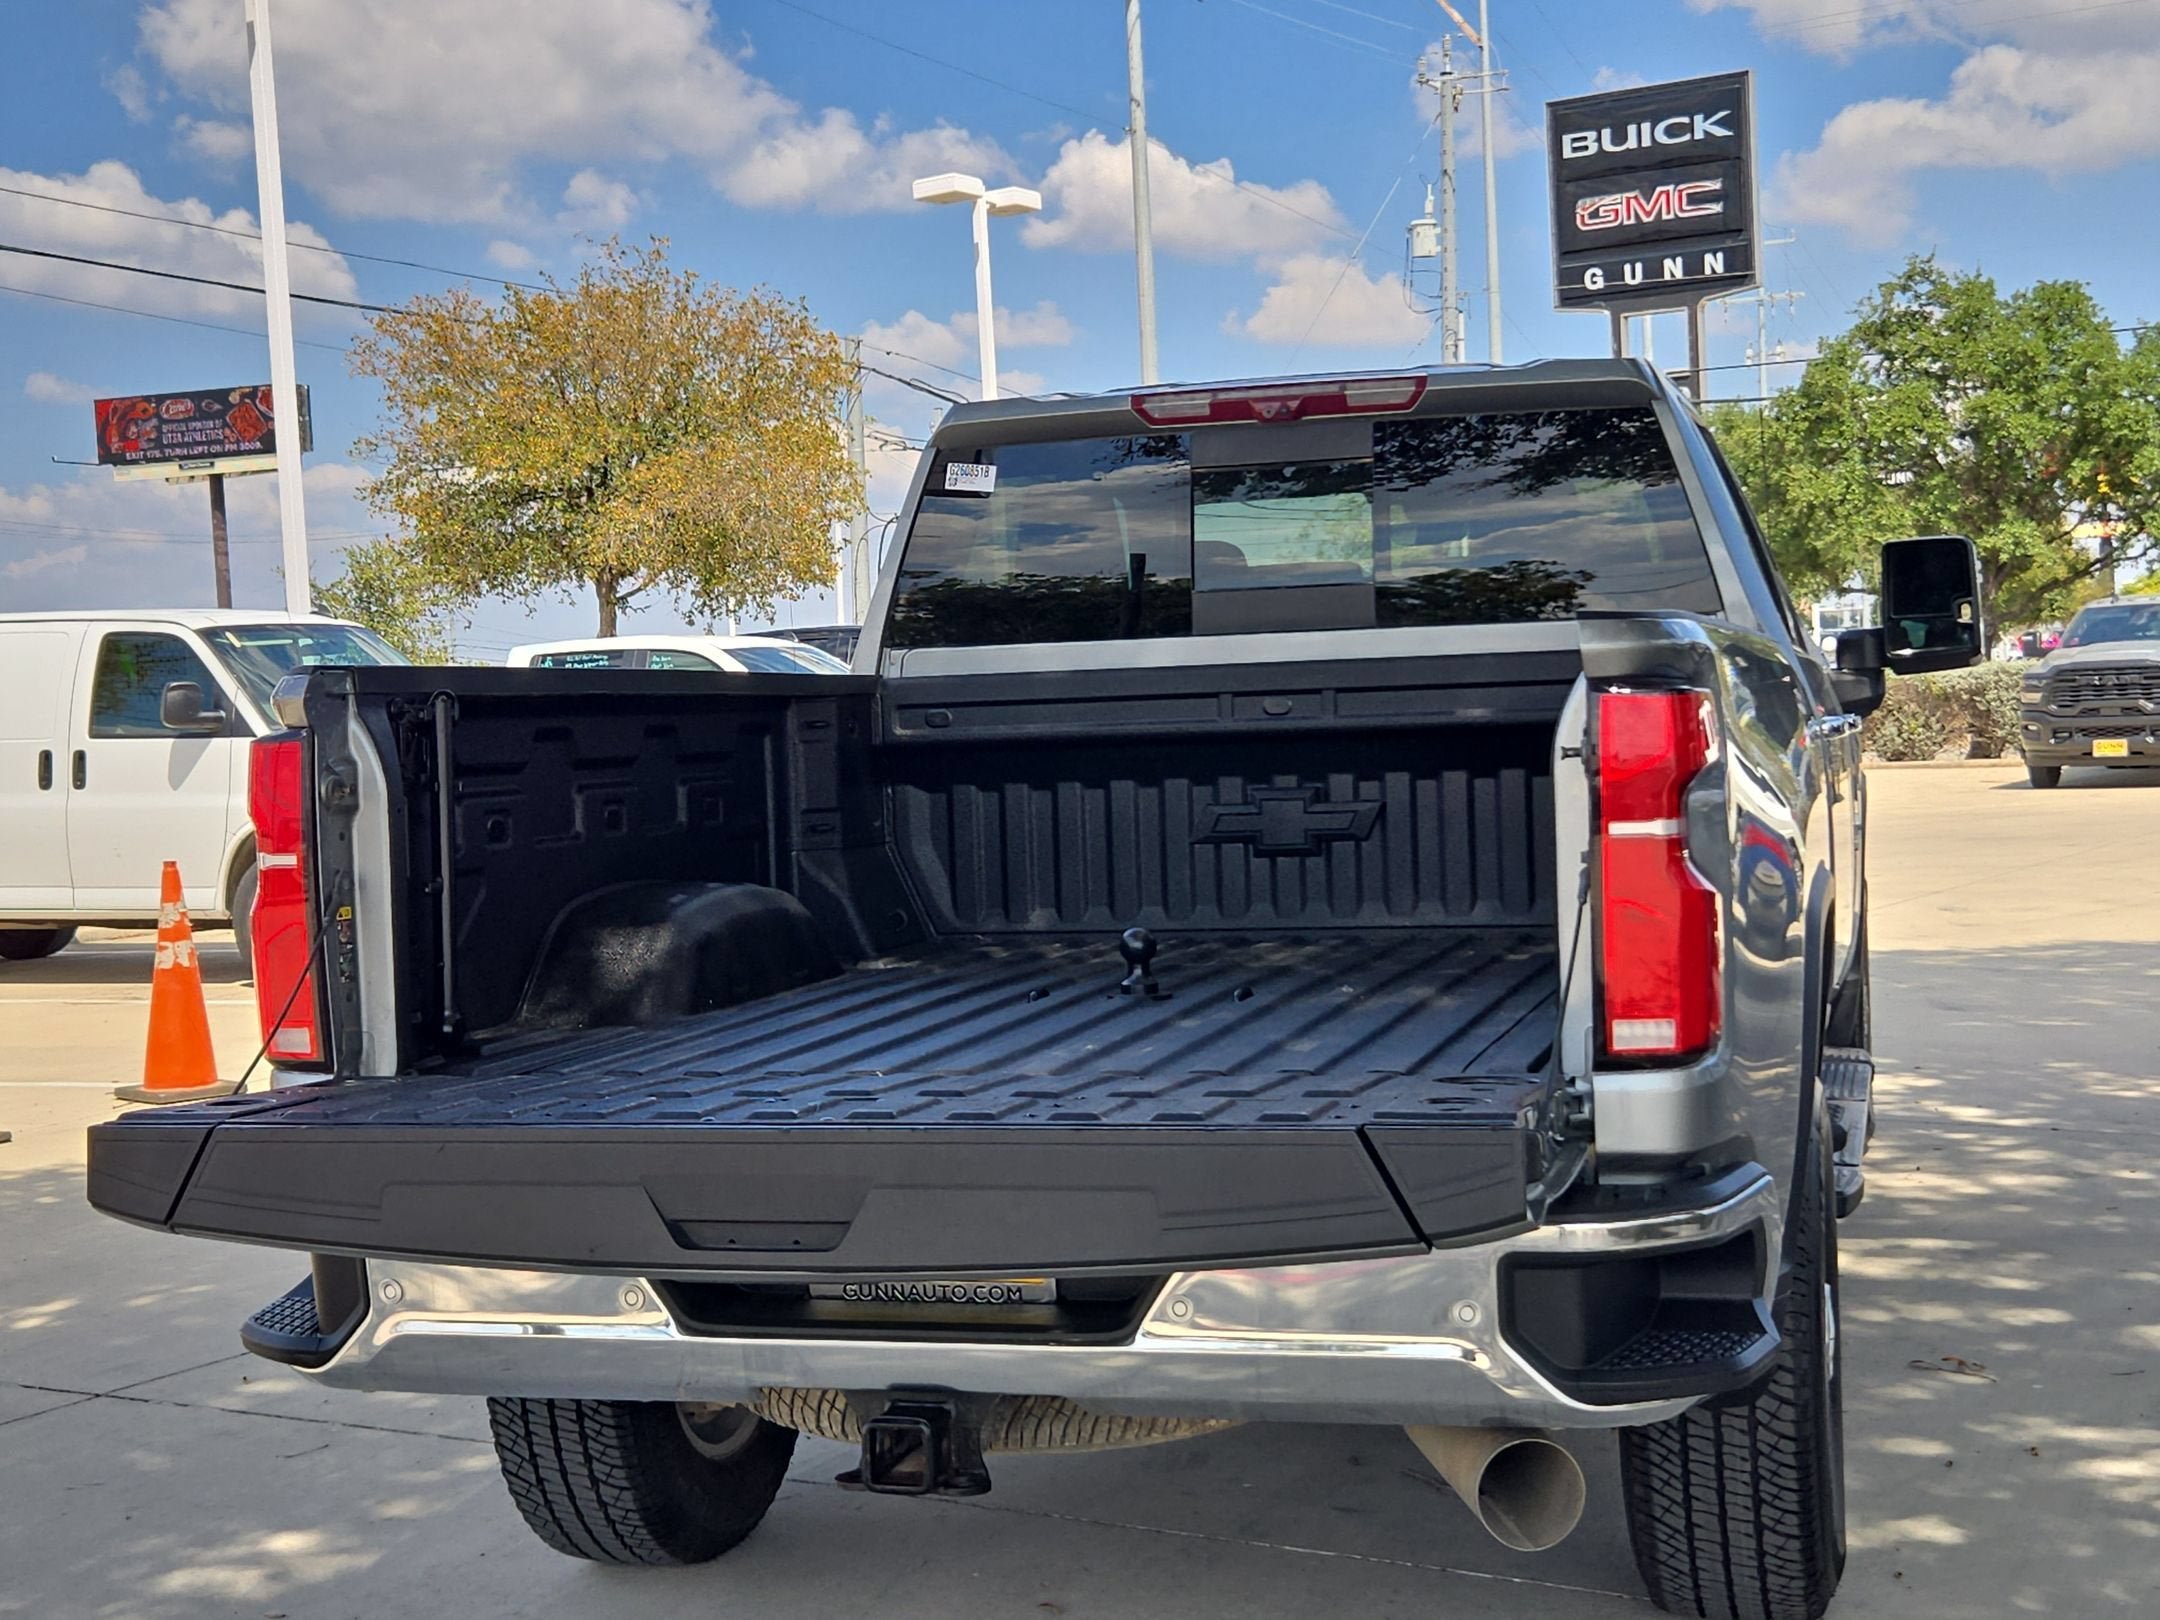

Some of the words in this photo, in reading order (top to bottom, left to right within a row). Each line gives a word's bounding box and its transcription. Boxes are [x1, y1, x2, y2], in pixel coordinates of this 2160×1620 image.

[1561, 110, 1735, 159] BUICK
[1575, 177, 1724, 231] GMC
[1583, 251, 1725, 290] GUNN
[184, 429, 224, 442] ATHLETICS
[164, 447, 188, 457] TURN
[189, 445, 208, 455] LEFT
[209, 444, 223, 453] ON
[843, 1283, 1022, 1303] GUNNAUTO.COM
